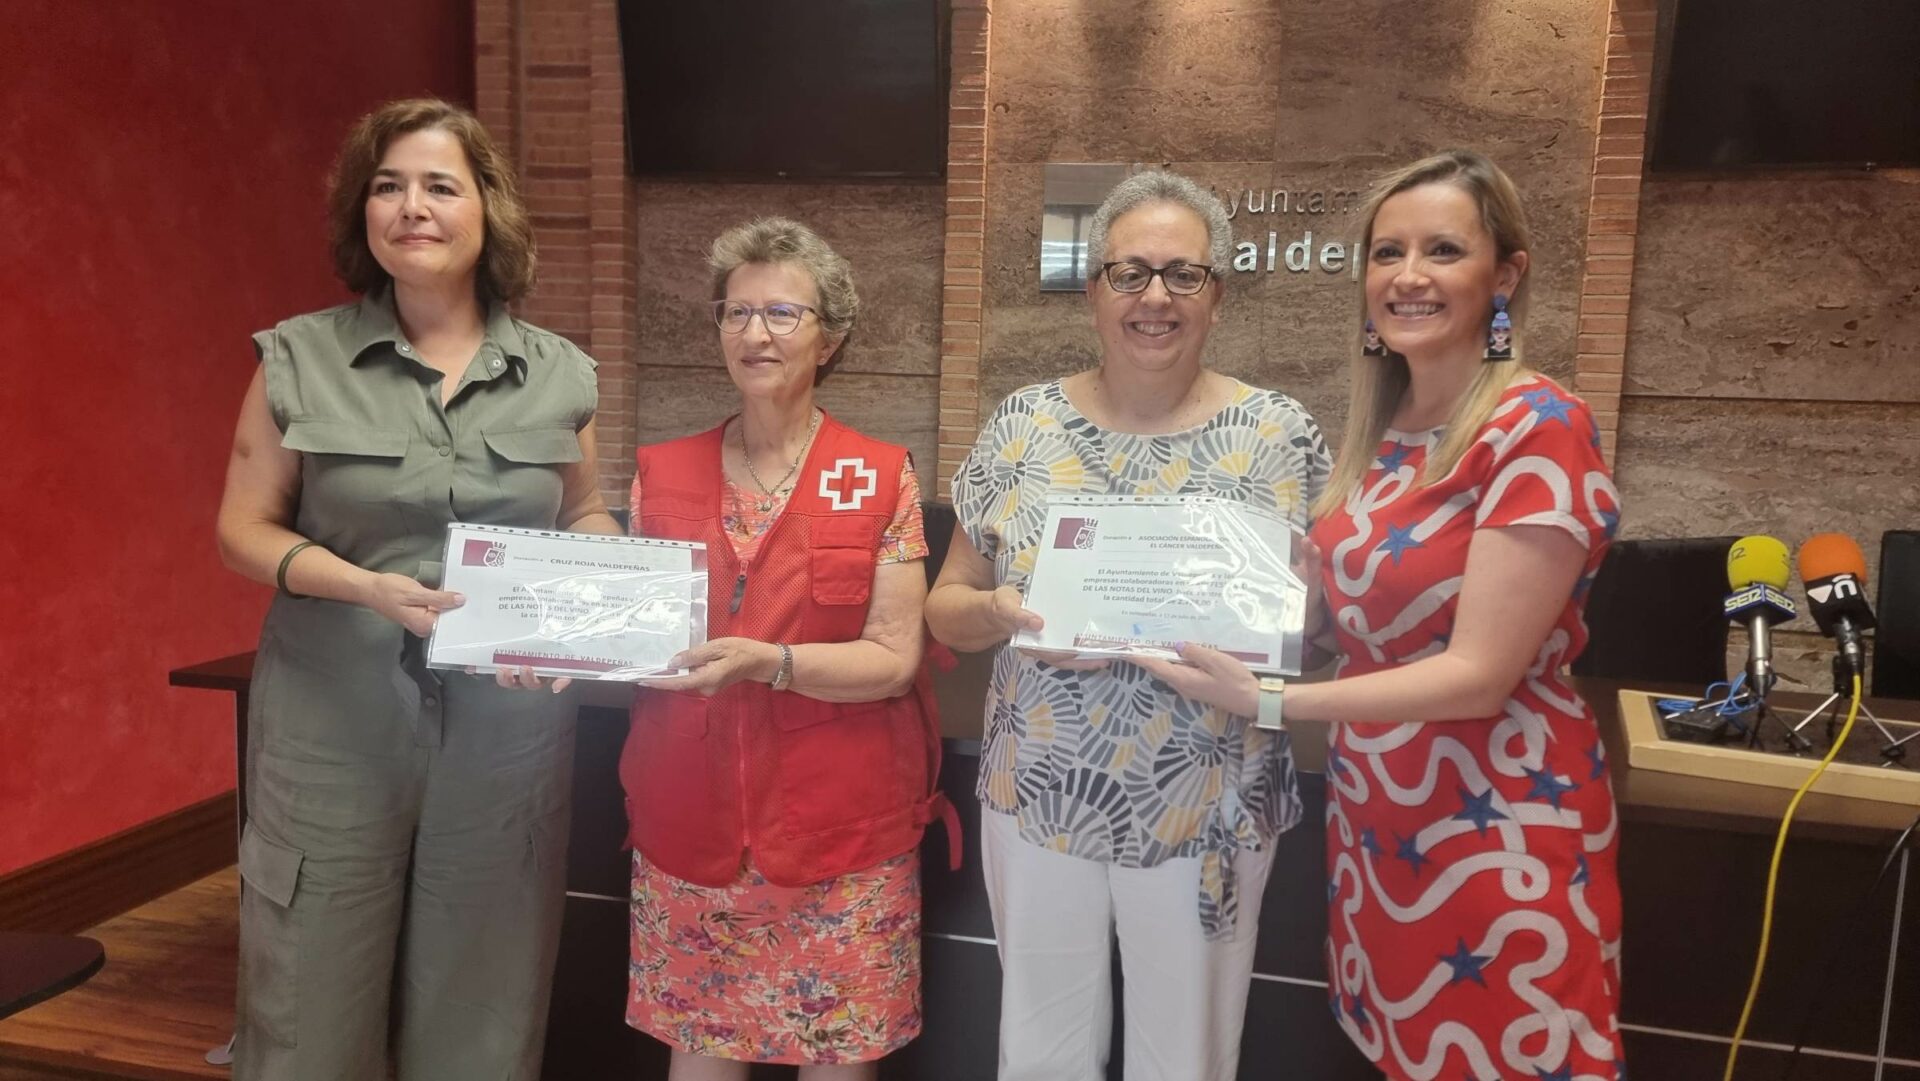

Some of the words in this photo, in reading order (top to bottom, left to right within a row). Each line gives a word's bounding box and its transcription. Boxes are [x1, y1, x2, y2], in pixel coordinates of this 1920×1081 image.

[1212, 184, 1373, 220] yuntam
[1233, 230, 1361, 281] alde
[597, 562, 651, 571] VALDEPEÑAS
[1106, 569, 1159, 577] Ayuntamiento
[1119, 577, 1174, 585] colaboradoras
[526, 603, 552, 611] NOS
[494, 648, 560, 659] AYUNTAMIENTO
[580, 655, 633, 667] VALDEPEÑAS
